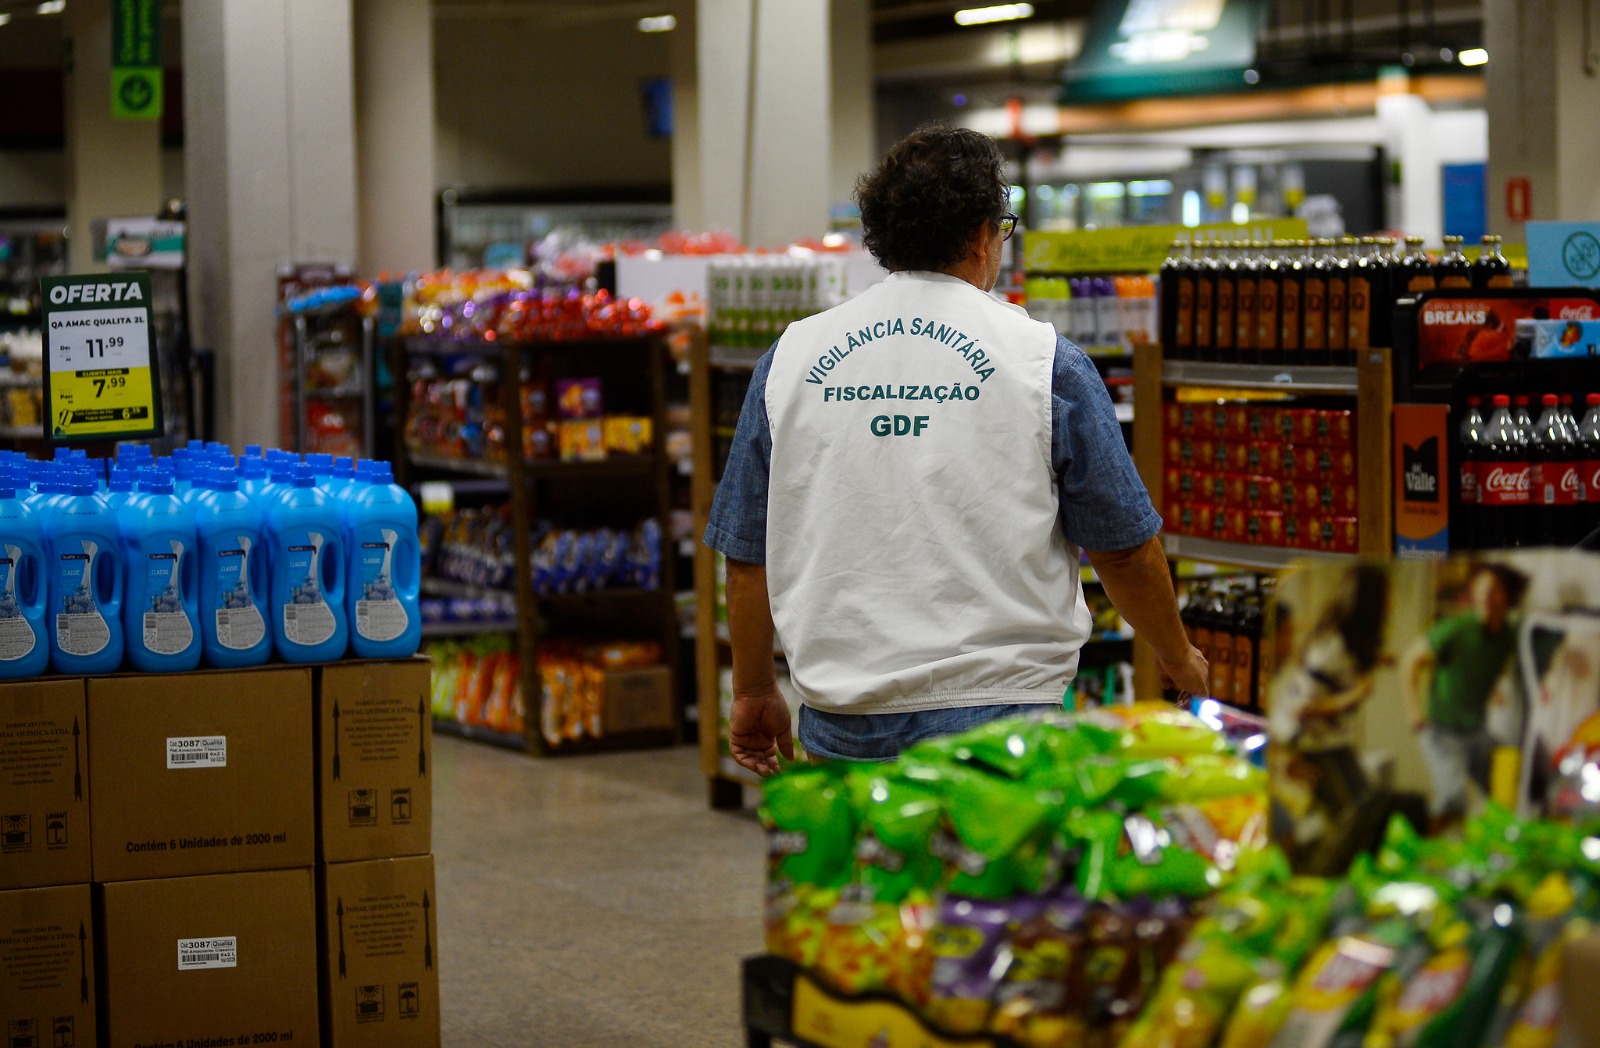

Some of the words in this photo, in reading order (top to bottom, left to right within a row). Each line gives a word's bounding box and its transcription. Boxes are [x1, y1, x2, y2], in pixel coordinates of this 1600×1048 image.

[49, 282, 143, 304] OFERTA
[51, 321, 63, 330] QA
[65, 319, 91, 328] AMAC
[93, 317, 132, 327] QUALITA
[134, 316, 144, 324] 2L
[1424, 310, 1487, 325] BREAKS
[86, 336, 124, 358] 11,99
[805, 317, 905, 386] VIGILÂNCIA
[910, 317, 996, 383] SANITÁRIA
[92, 377, 126, 398] 7,99
[824, 382, 980, 404] FISCALIZAÇÃO
[870, 414, 930, 437] GDF
[1406, 472, 1436, 492] Valle
[17, 729, 48, 738] QUÍMICA
[177, 740, 200, 748] 3087
[126, 839, 167, 853] Contém
[169, 839, 177, 849] 6
[179, 835, 228, 849] Unidades
[230, 835, 243, 846] de
[245, 833, 271, 845] 2000
[273, 832, 287, 843] ml
[189, 941, 211, 949] 3087
[177, 1039, 184, 1048] 6
[186, 1036, 235, 1048] Unidades
[237, 1034, 250, 1045] de
[252, 1032, 278, 1044] 2000
[280, 1030, 293, 1041] ml
